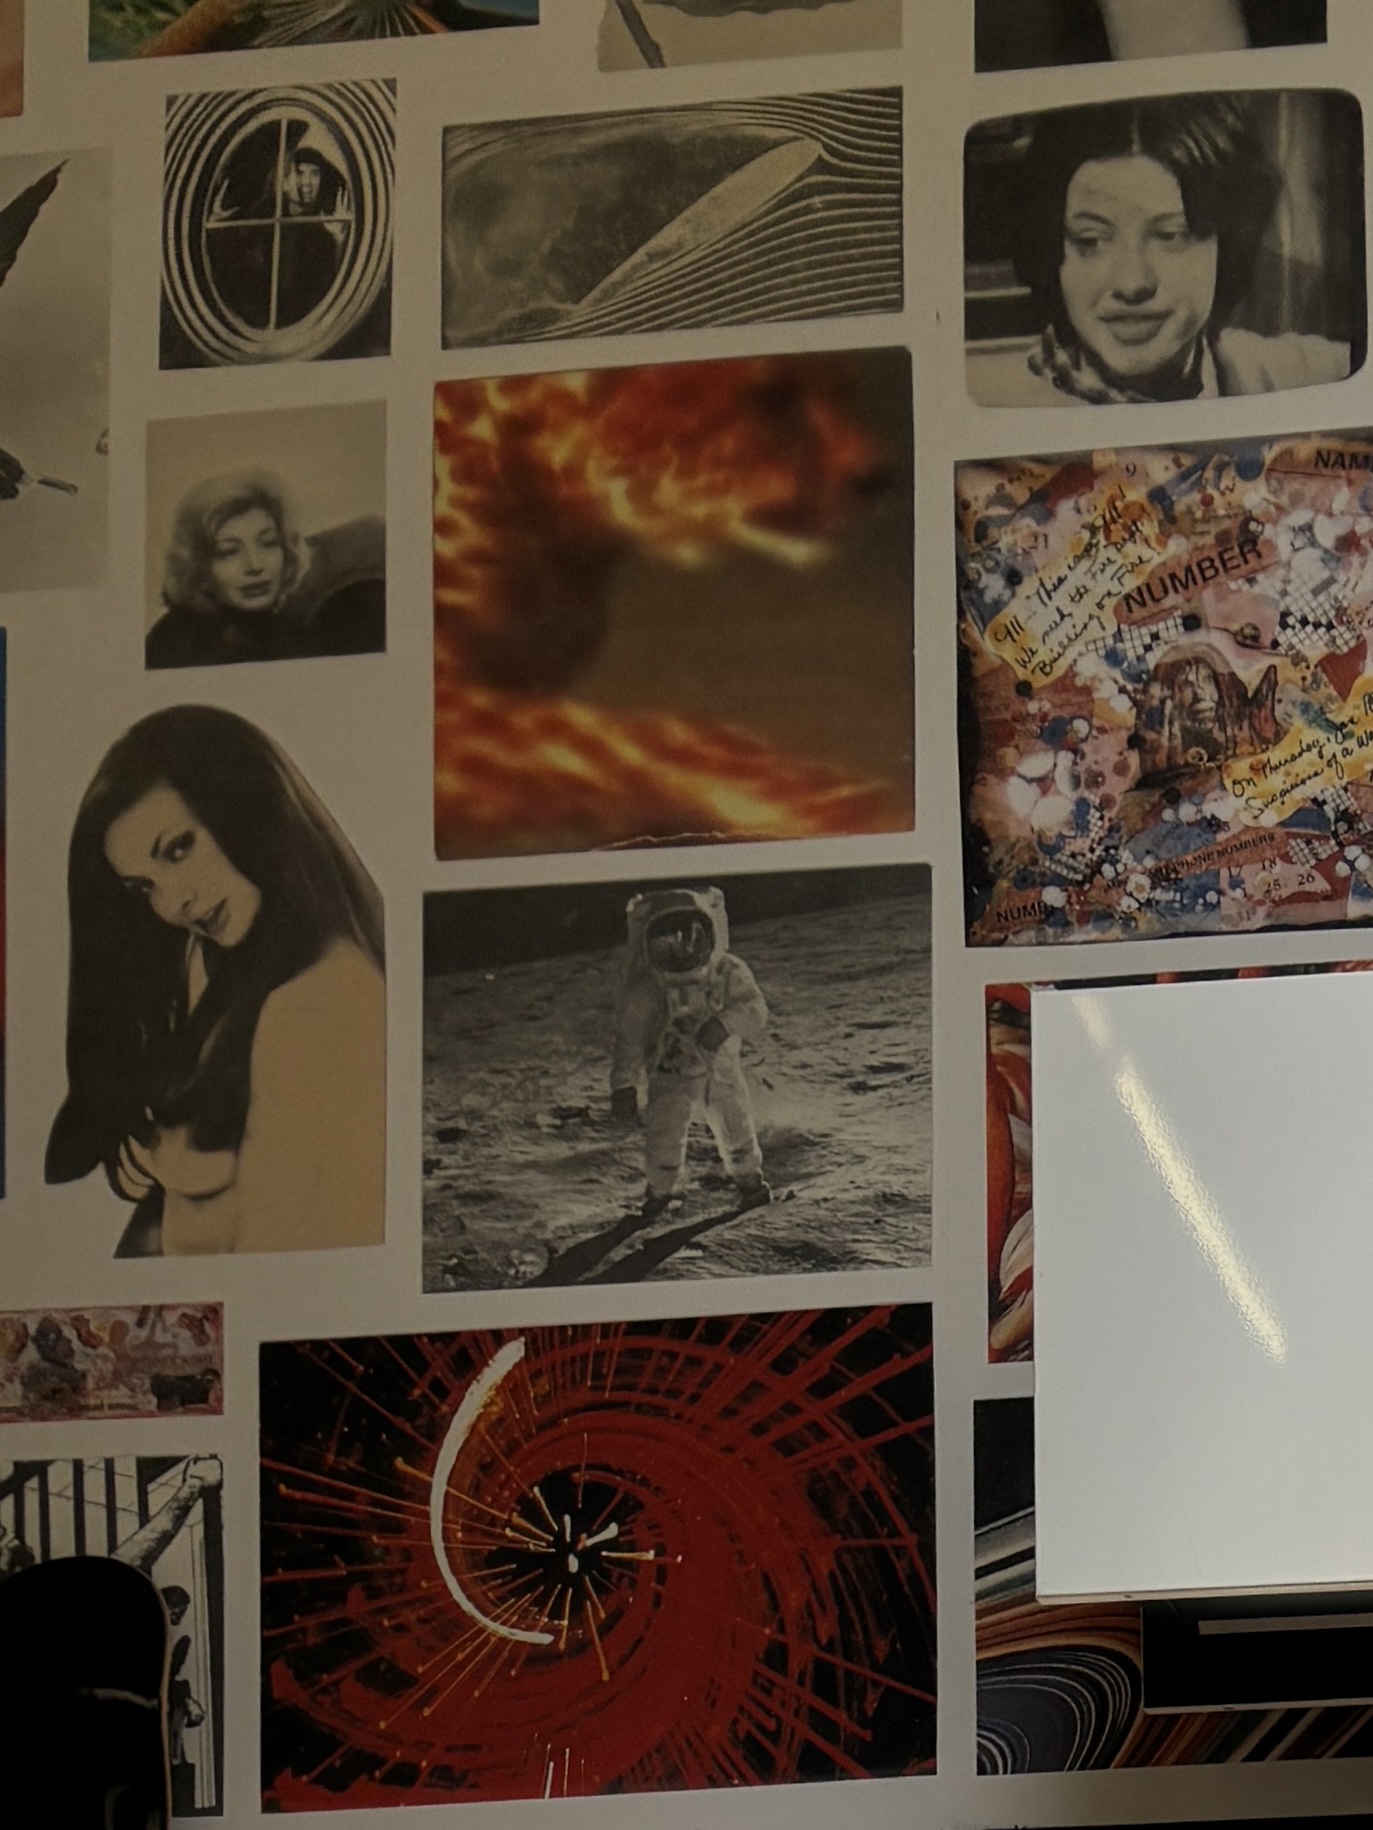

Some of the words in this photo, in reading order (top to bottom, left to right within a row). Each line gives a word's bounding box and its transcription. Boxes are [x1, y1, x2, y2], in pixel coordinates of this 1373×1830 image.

[1124, 537, 1263, 615] NUMBER
[1015, 646, 1038, 669] We
[1327, 753, 1345, 780] of
